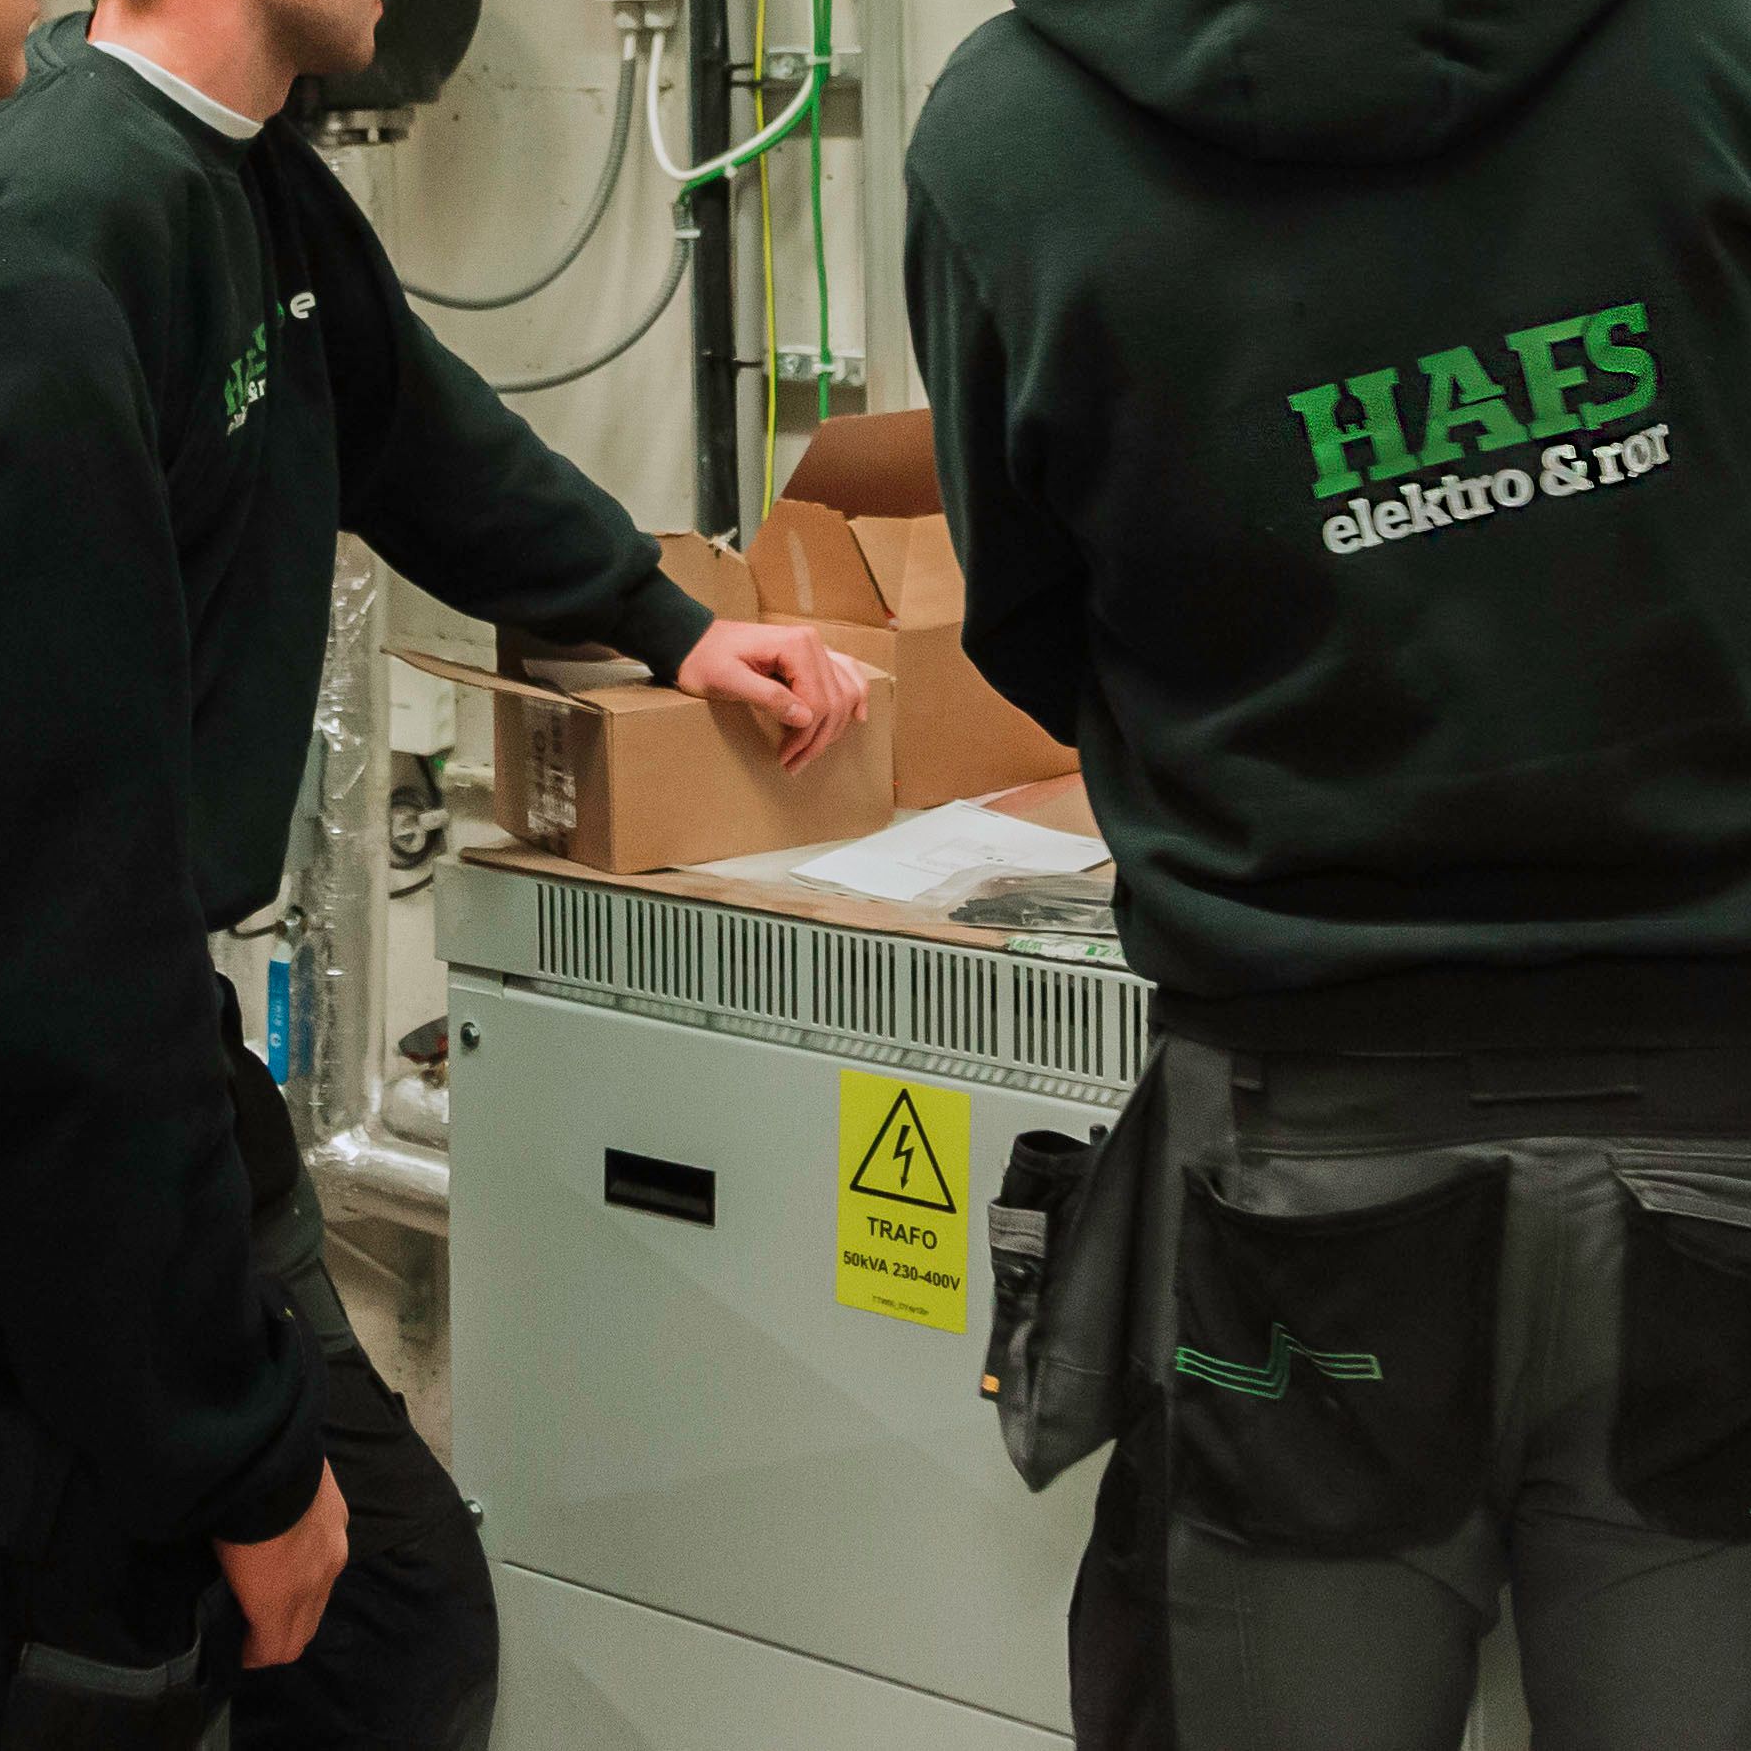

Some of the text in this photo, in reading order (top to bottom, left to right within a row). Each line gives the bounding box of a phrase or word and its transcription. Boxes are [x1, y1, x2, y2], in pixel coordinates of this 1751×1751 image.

[1287, 301, 1659, 500] HAFS
[1321, 467, 1535, 555] elektro
[1539, 443, 1595, 498] &
[843, 1250, 961, 1292] 50kVA 230-400V
[866, 1216, 938, 1250] TRAFO
